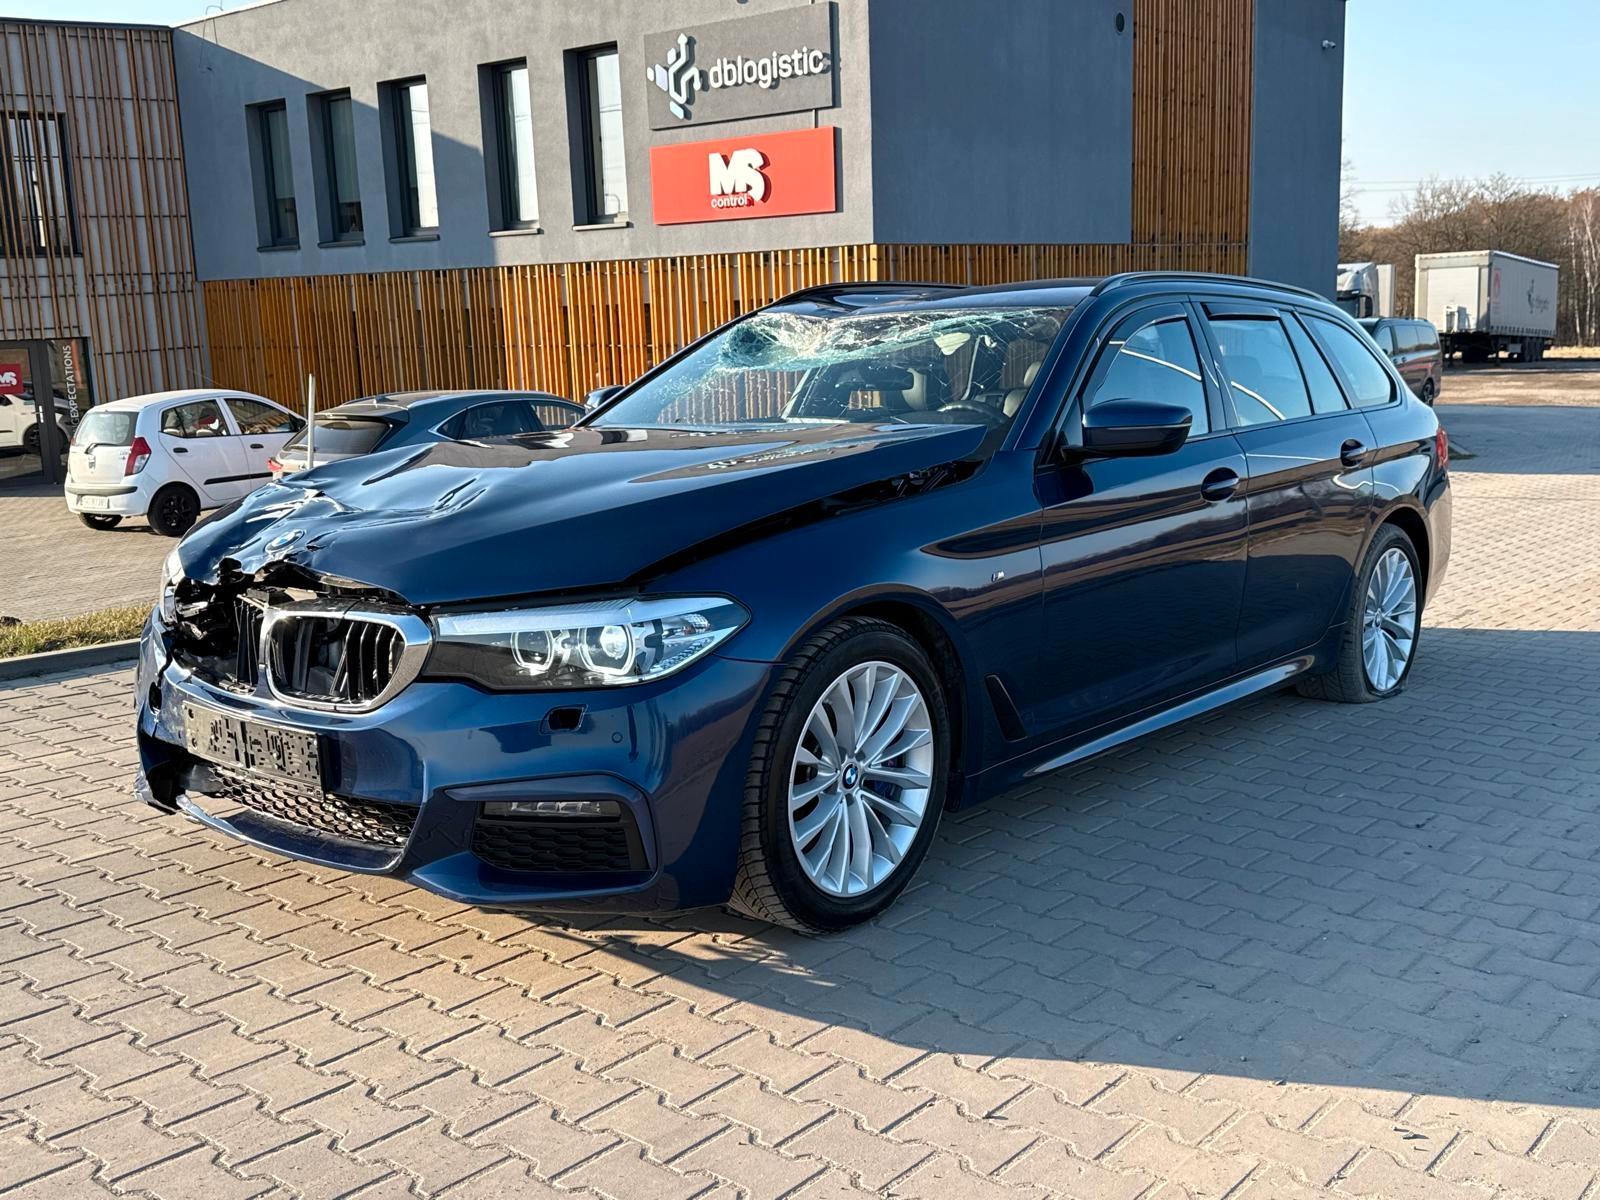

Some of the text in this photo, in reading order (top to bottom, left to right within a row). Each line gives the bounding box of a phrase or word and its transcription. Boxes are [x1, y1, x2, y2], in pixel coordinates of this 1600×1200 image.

[709, 46, 824, 89] dblogistic
[708, 148, 765, 202] MS
[711, 194, 748, 208] control
